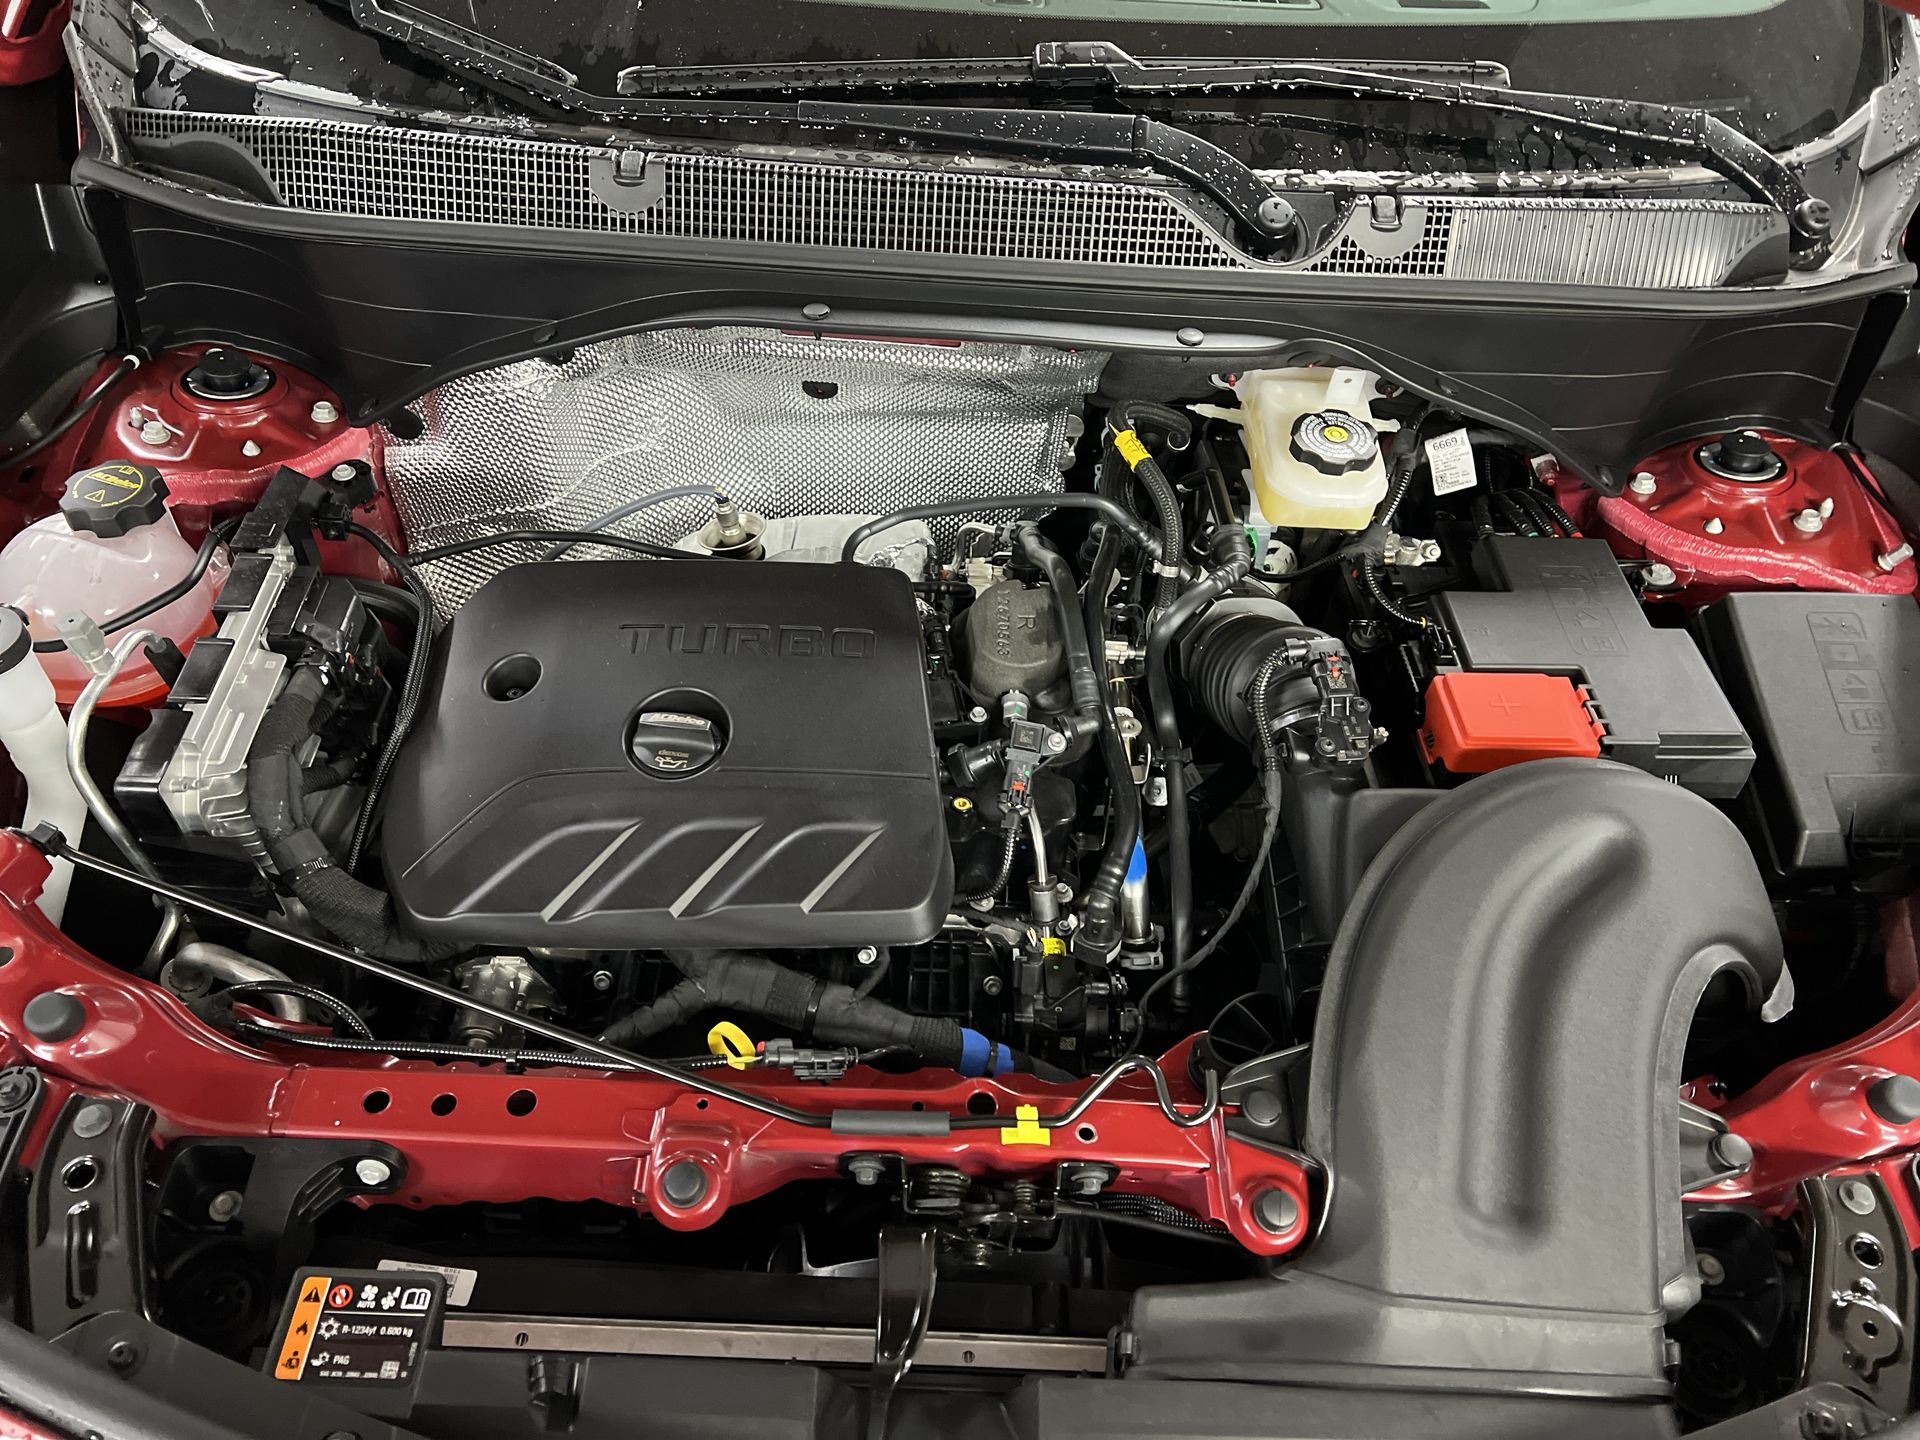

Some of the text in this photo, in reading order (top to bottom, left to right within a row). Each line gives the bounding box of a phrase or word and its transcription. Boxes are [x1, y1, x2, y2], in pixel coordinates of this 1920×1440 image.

[1433, 437, 1458, 451] 6669
[90, 472, 140, 490] ACDelco
[996, 589, 1010, 656] 12670563
[1017, 614, 1036, 630] R
[618, 623, 878, 658] TURBO
[650, 713, 706, 726] ACDelco
[356, 1300, 376, 1309] AUTO
[341, 1325, 376, 1336] R-1234yf
[402, 1327, 414, 1338] kg
[333, 1355, 350, 1366] PAG
